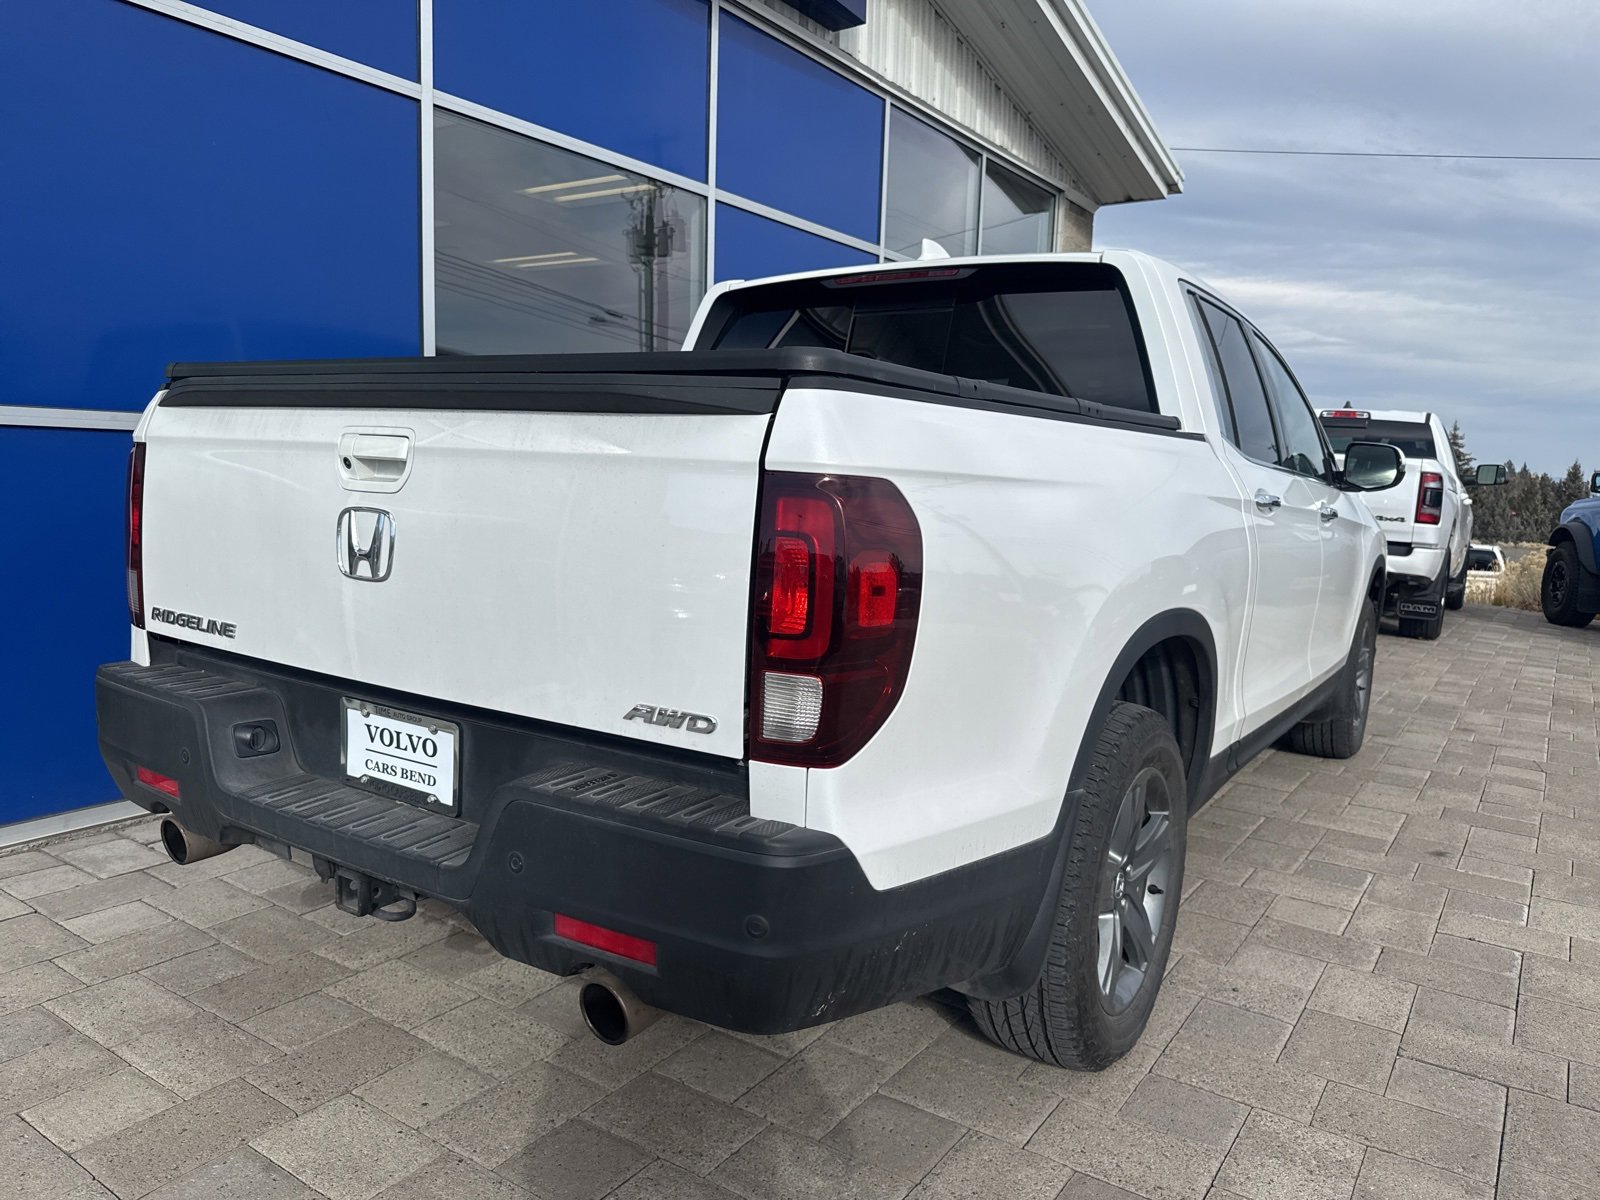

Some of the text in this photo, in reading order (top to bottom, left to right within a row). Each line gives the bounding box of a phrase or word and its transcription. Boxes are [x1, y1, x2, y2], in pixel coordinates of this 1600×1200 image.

[151, 606, 237, 639] RIDGELINE
[1400, 602, 1437, 614] RAM
[373, 705, 391, 718] TIME
[622, 703, 718, 735] AWD
[364, 723, 438, 758] VOLVO
[365, 758, 437, 787] CARS BEND
